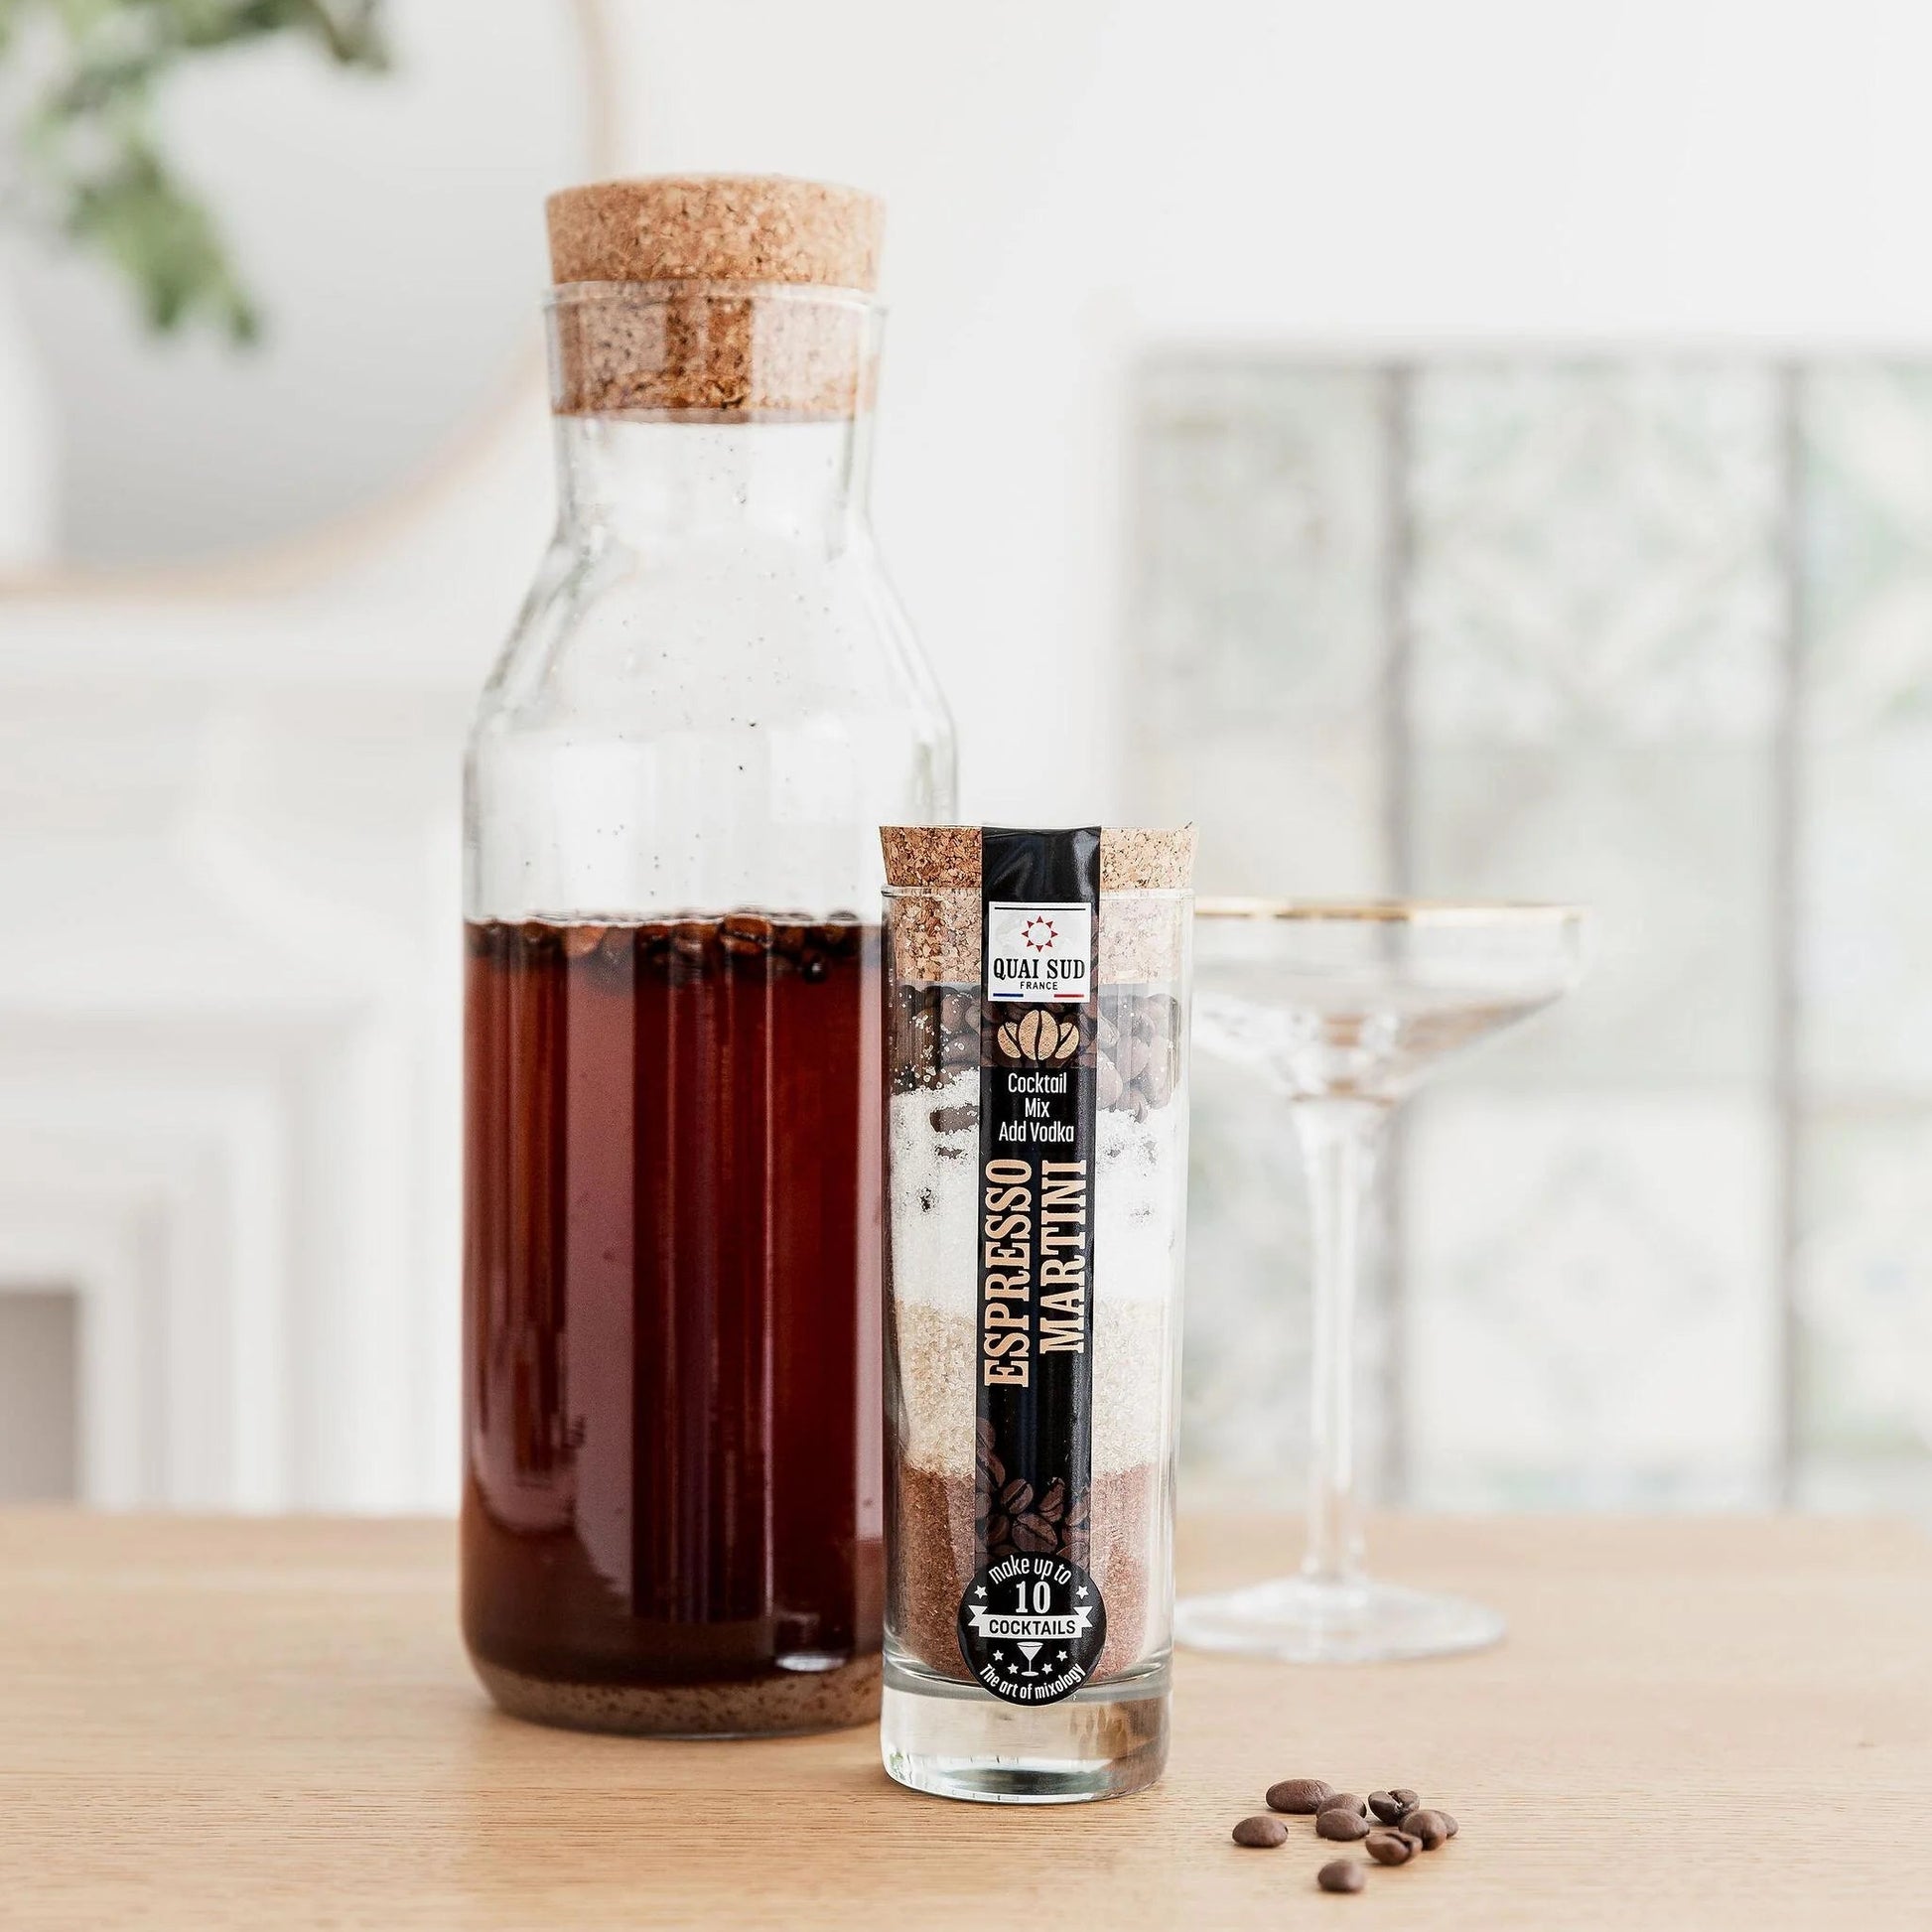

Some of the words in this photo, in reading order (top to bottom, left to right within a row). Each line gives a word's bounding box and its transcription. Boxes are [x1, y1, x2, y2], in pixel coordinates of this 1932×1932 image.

[993, 958, 1039, 981] QUAI
[1046, 959, 1085, 980] SUD
[1020, 981, 1058, 991] FRANCE
[1008, 1071, 1067, 1094] Cocktail
[1025, 1097, 1050, 1118] Mix
[998, 1120, 1027, 1143] Add
[1030, 1120, 1074, 1143] Vodka
[1038, 1160, 1087, 1355] MARTINI
[983, 1159, 1033, 1388] ESPRESSO
[988, 1554, 1031, 1585] make
[1034, 1558, 1054, 1580] up
[1055, 1563, 1072, 1586] to
[1015, 1581, 1051, 1614] 10
[989, 1618, 1076, 1636] COCKTAILS
[979, 1663, 1000, 1687] The
[998, 1681, 1017, 1698] art
[1020, 1683, 1033, 1700] of
[1035, 1663, 1087, 1700] mixology
